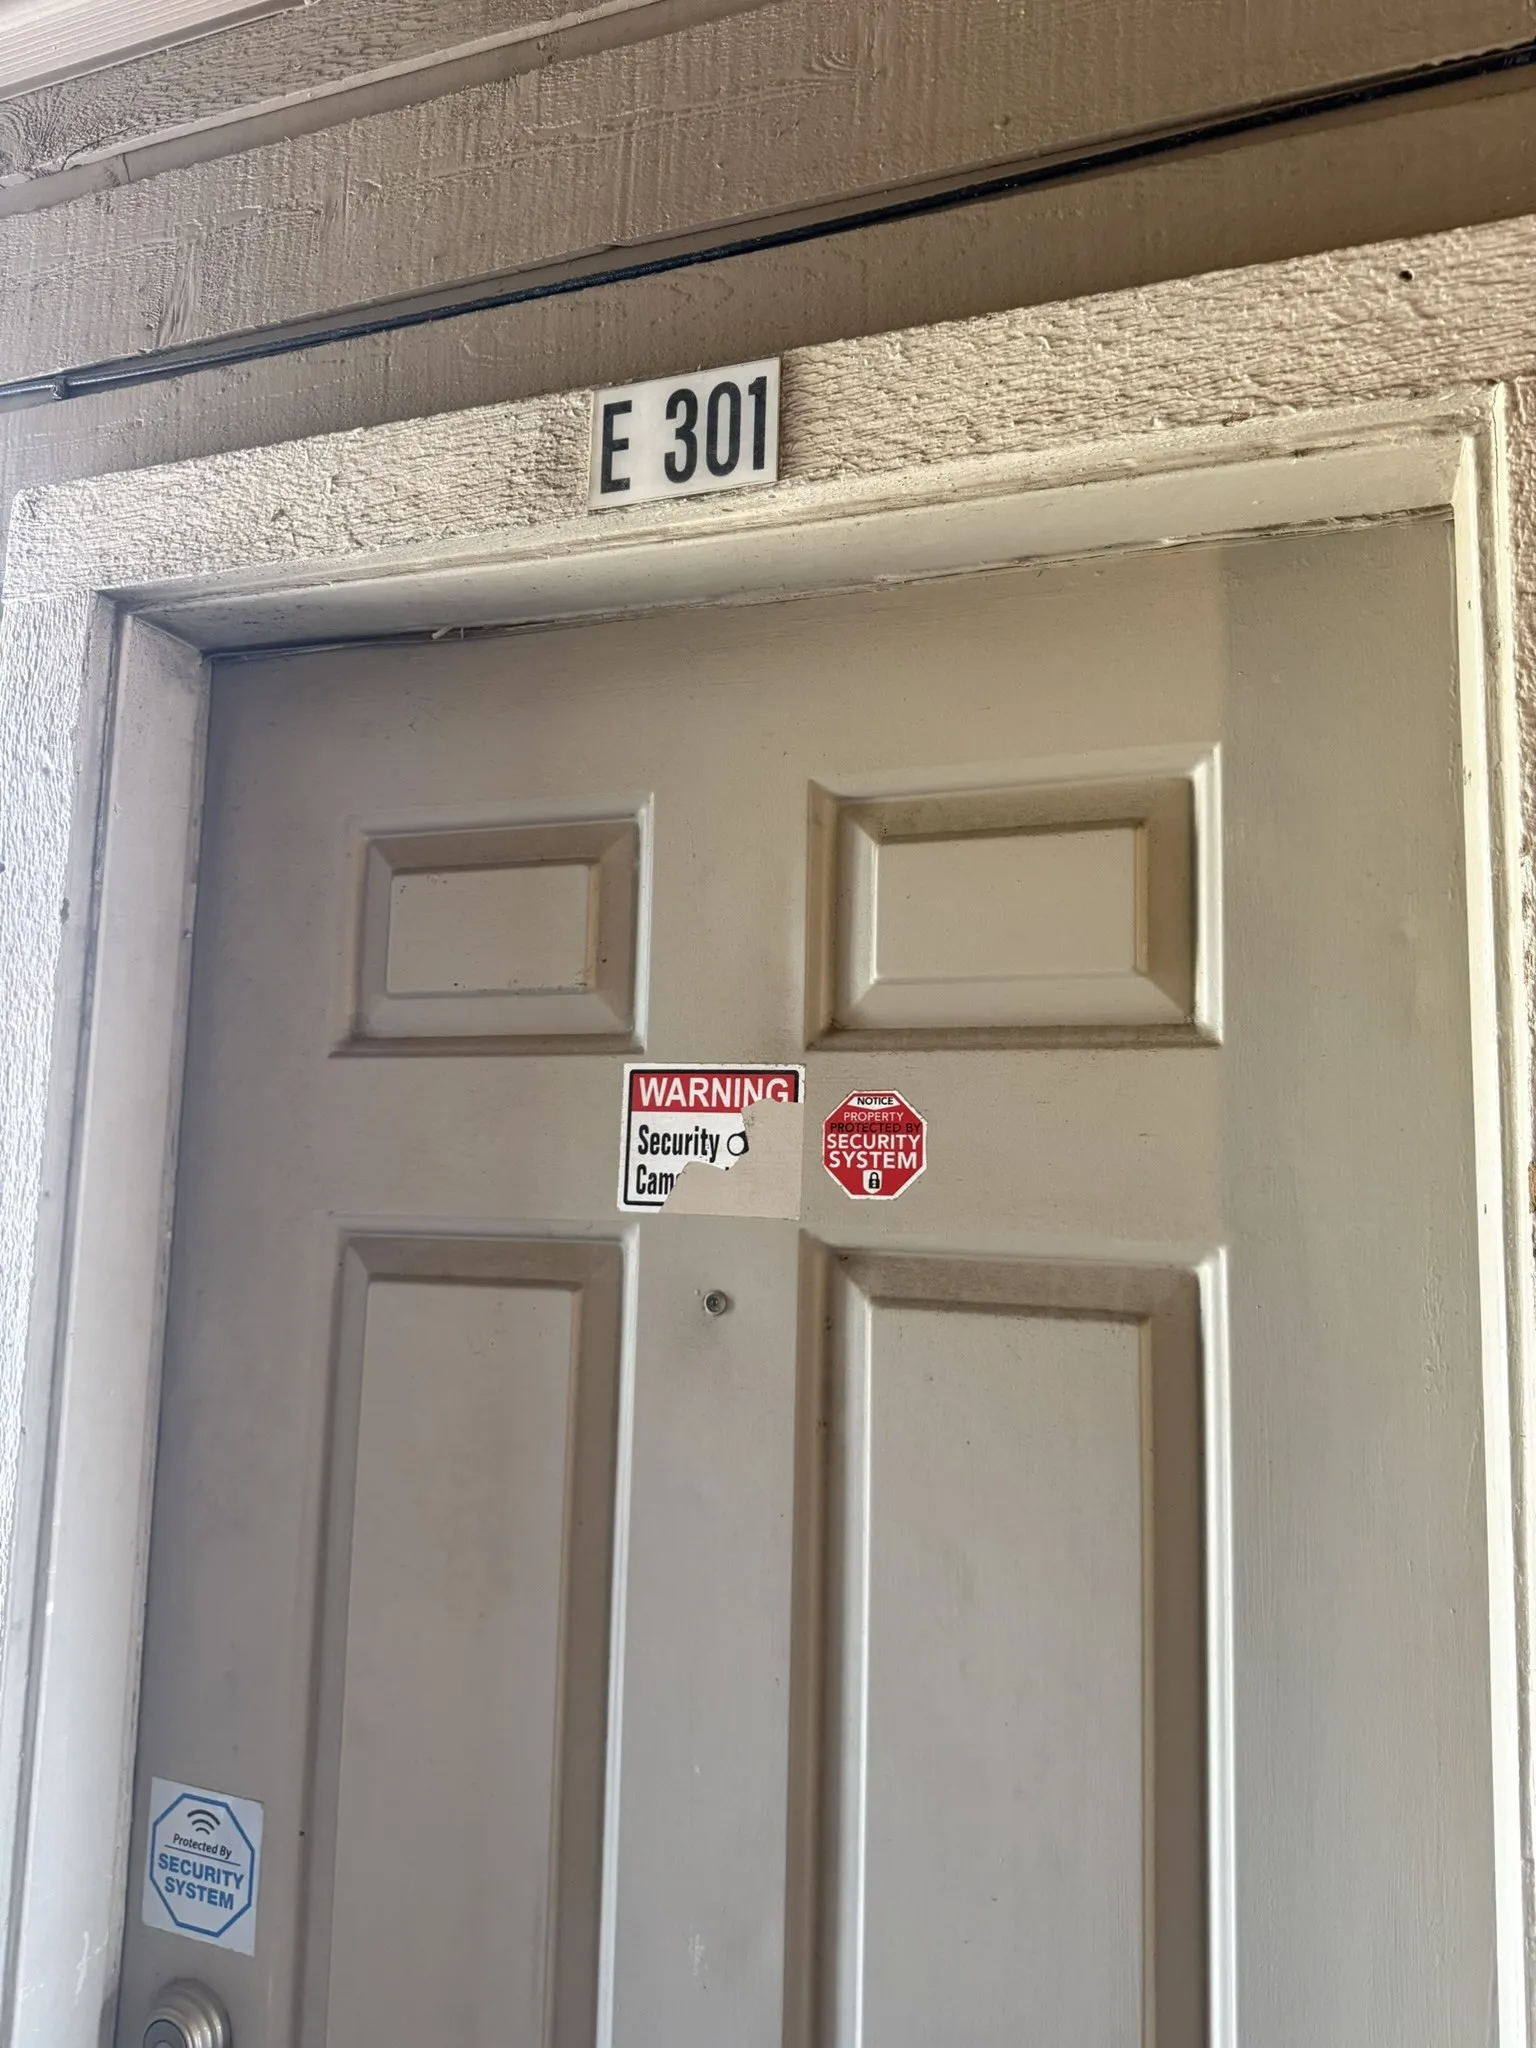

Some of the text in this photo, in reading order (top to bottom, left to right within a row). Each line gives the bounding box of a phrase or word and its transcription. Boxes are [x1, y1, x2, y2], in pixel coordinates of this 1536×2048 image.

[601, 376, 768, 494] E 301
[639, 1077, 789, 1108] WARNING
[857, 1097, 894, 1106] NOTICE
[830, 1122, 921, 1133] PROTECTED BY
[843, 1111, 904, 1122] PROPERTY
[637, 1124, 720, 1163] Security
[826, 1133, 921, 1150] SECURITY
[829, 1150, 917, 1169] SYSTEM
[636, 1163, 681, 1195] Cam
[172, 1833, 233, 1860] Protected By
[158, 1853, 244, 1890] SECURITY
[164, 1876, 234, 1910] SYSTEM
